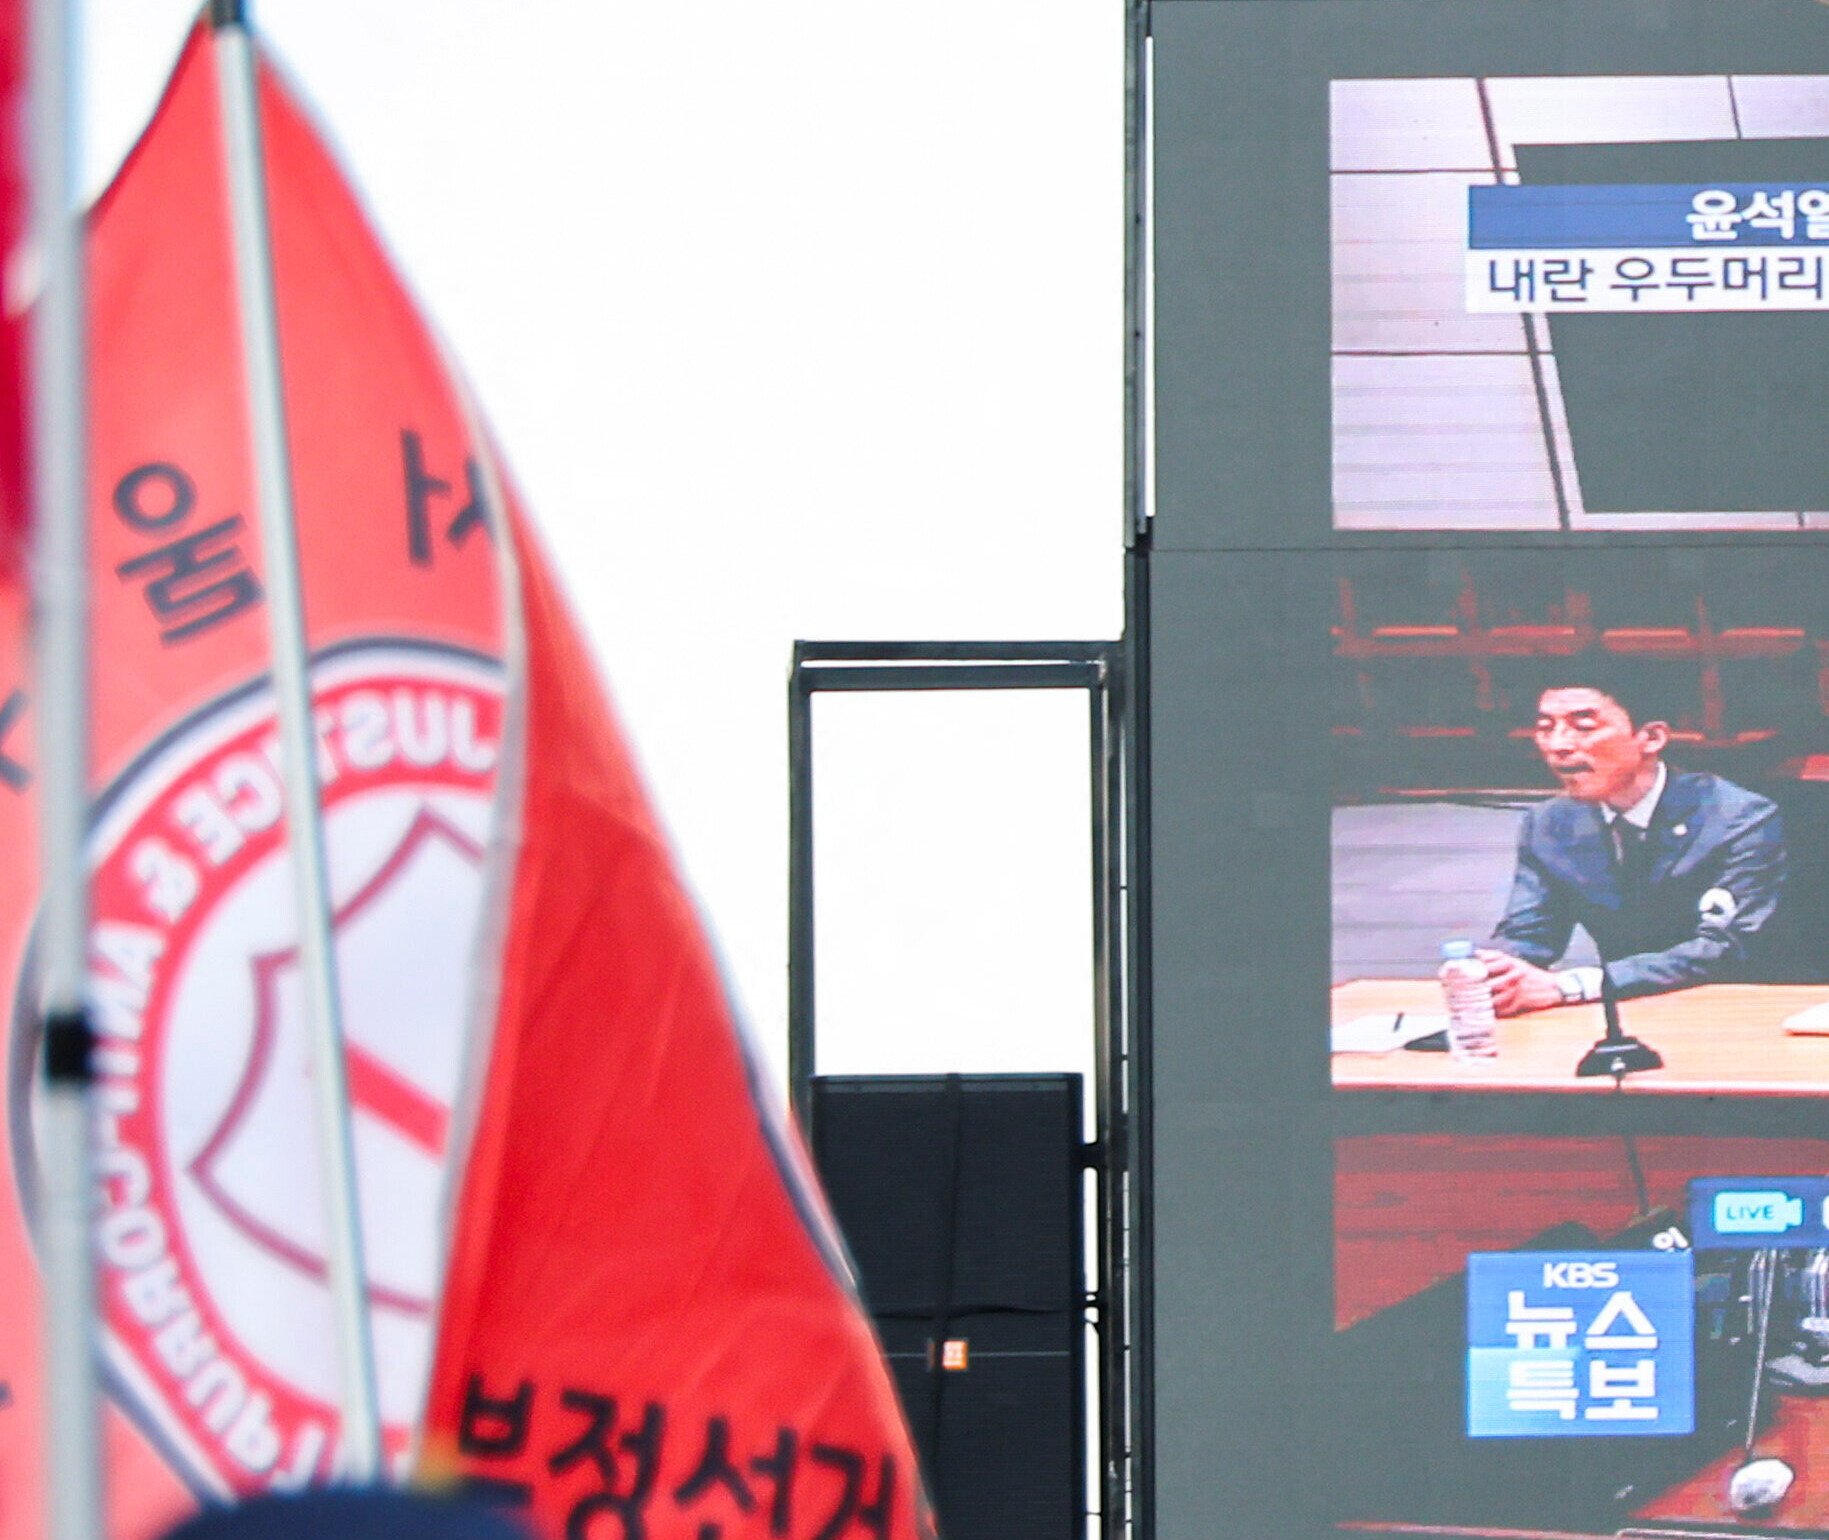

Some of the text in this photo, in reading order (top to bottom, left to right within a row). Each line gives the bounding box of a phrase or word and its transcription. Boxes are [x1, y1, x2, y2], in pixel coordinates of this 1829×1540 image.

[1489, 258, 1593, 304] 내란
[1608, 255, 1824, 302] 우두머리
[1726, 1205, 1776, 1221] LIVE
[1543, 1262, 1620, 1289] KBS
[1505, 1290, 1659, 1350] 뉴스
[1506, 1359, 1660, 1421] 특보
